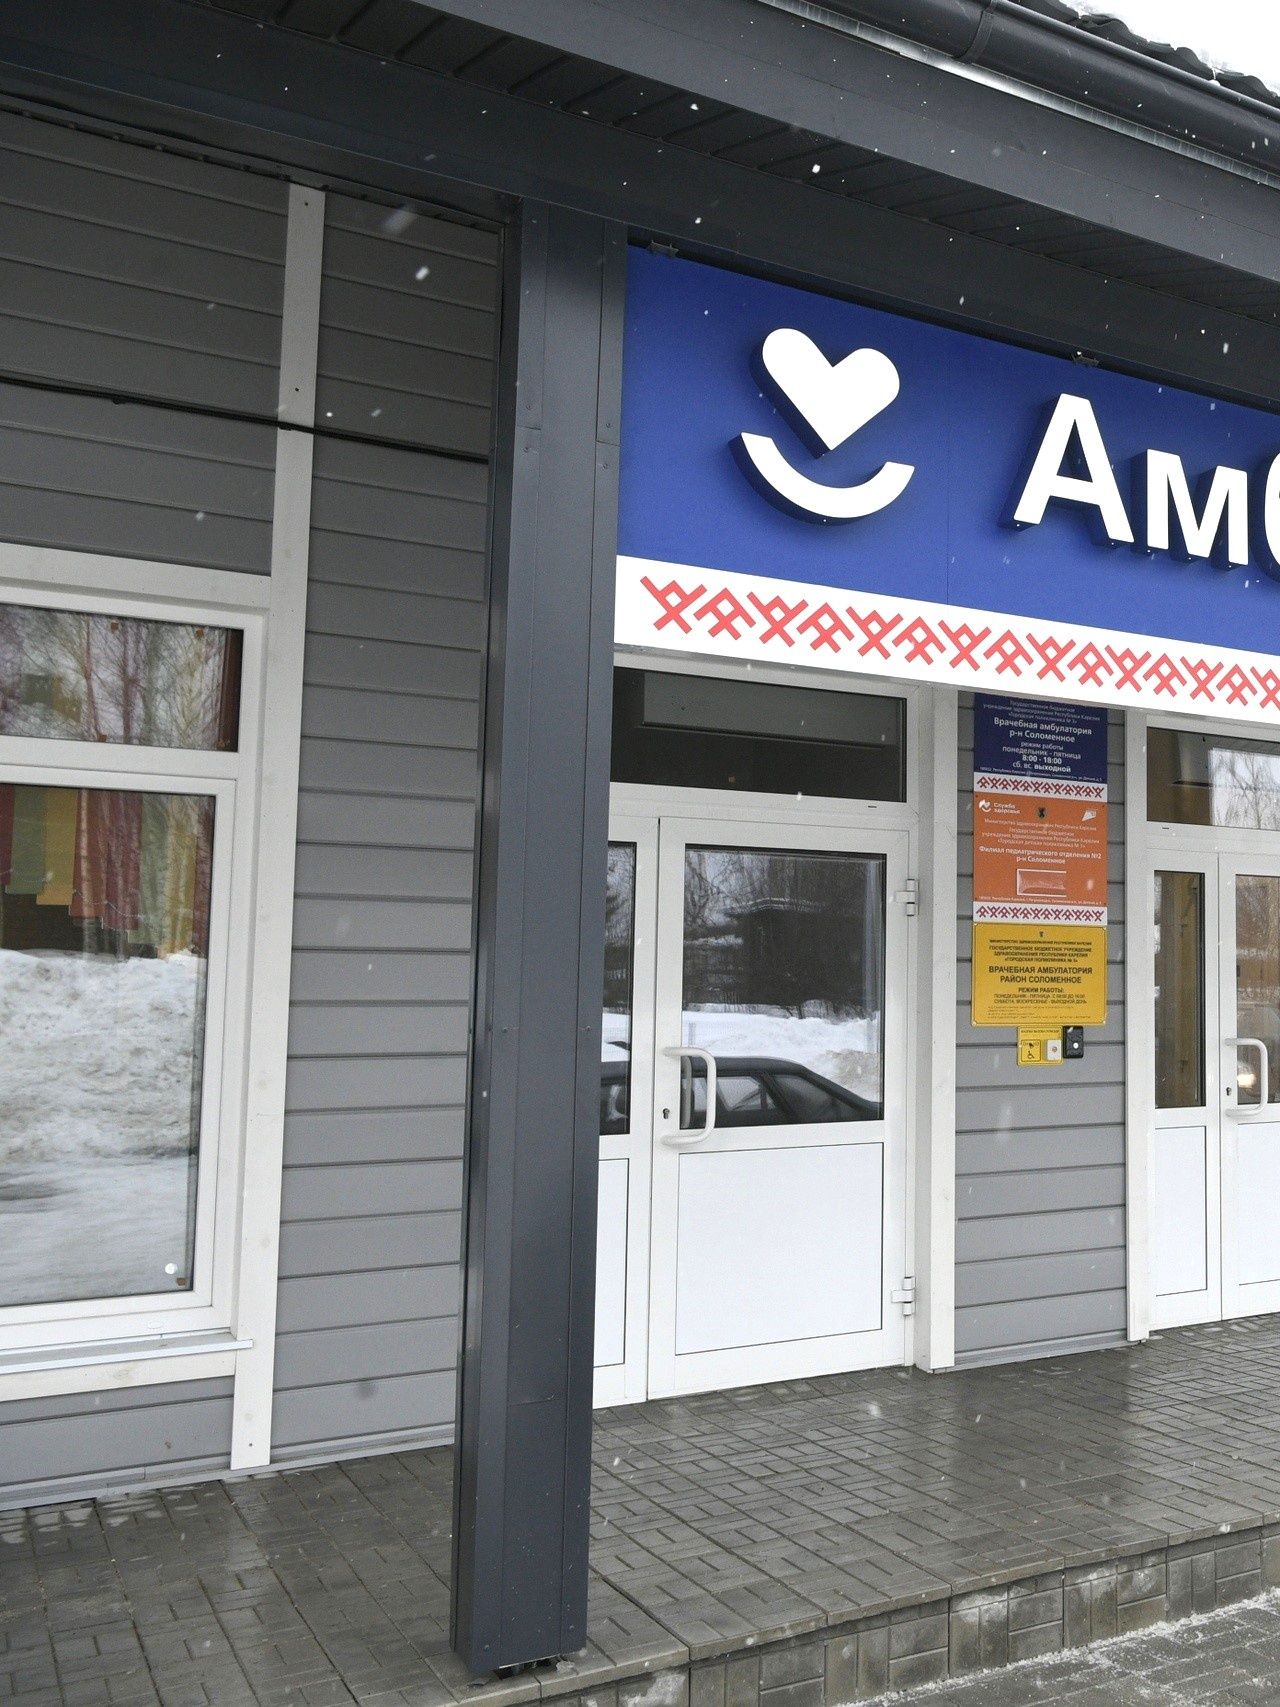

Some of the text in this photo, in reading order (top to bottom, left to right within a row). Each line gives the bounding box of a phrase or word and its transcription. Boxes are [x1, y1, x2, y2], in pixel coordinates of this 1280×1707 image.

[994, 717, 1092, 735] Врачебная амбулатория
[1010, 730, 1075, 742] р-н Соломенное
[1002, 746, 1048, 756] понедельник
[1054, 752, 1081, 760] пятница
[979, 846, 1004, 854] Филиал
[1006, 848, 1058, 857] педиатрического
[1028, 856, 1065, 864] Соломенное
[1000, 975, 1081, 984] РАЙОН СОЛОМЕННОЕ
